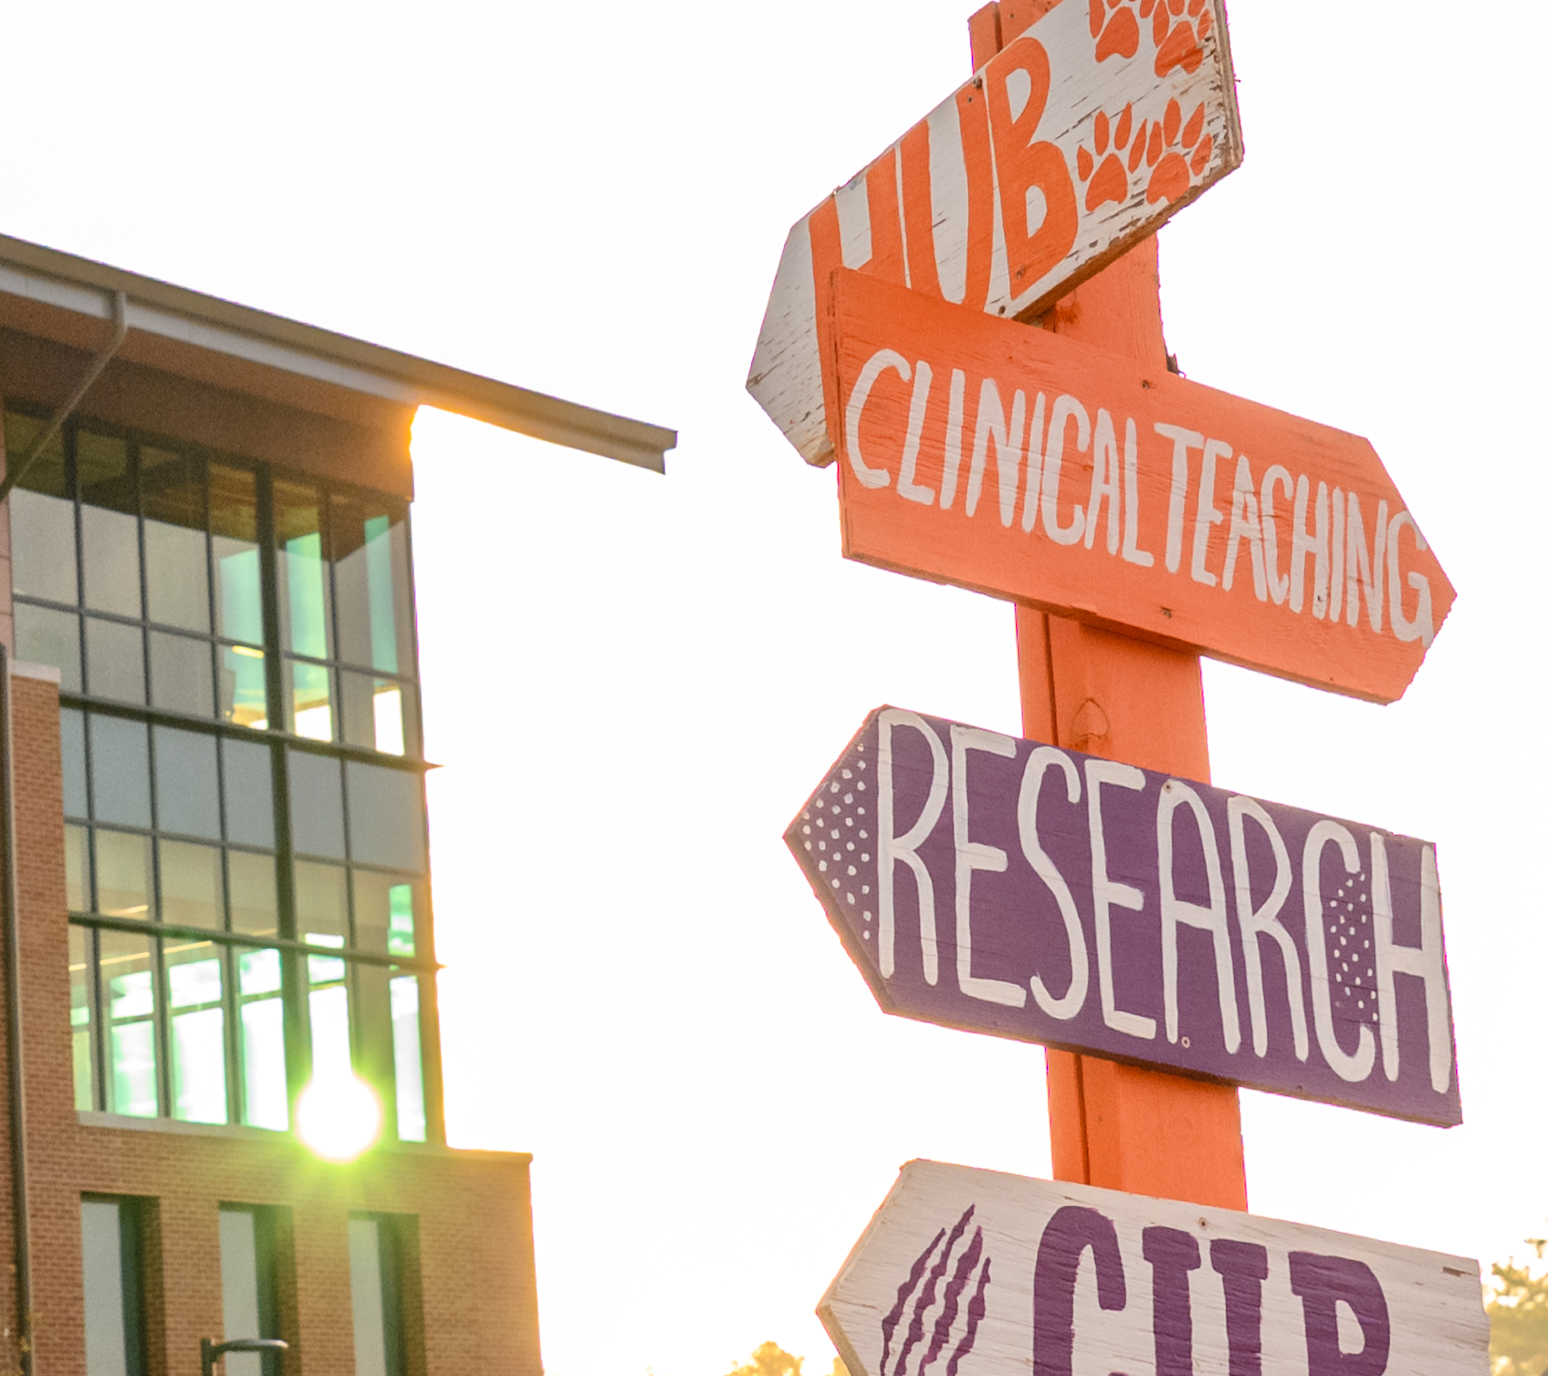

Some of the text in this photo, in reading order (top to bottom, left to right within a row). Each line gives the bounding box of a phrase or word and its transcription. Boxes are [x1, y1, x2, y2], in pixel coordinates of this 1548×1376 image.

[845, 348, 1435, 648] CLINICAL TEACHING
[877, 708, 1452, 1094] RESEARCH
